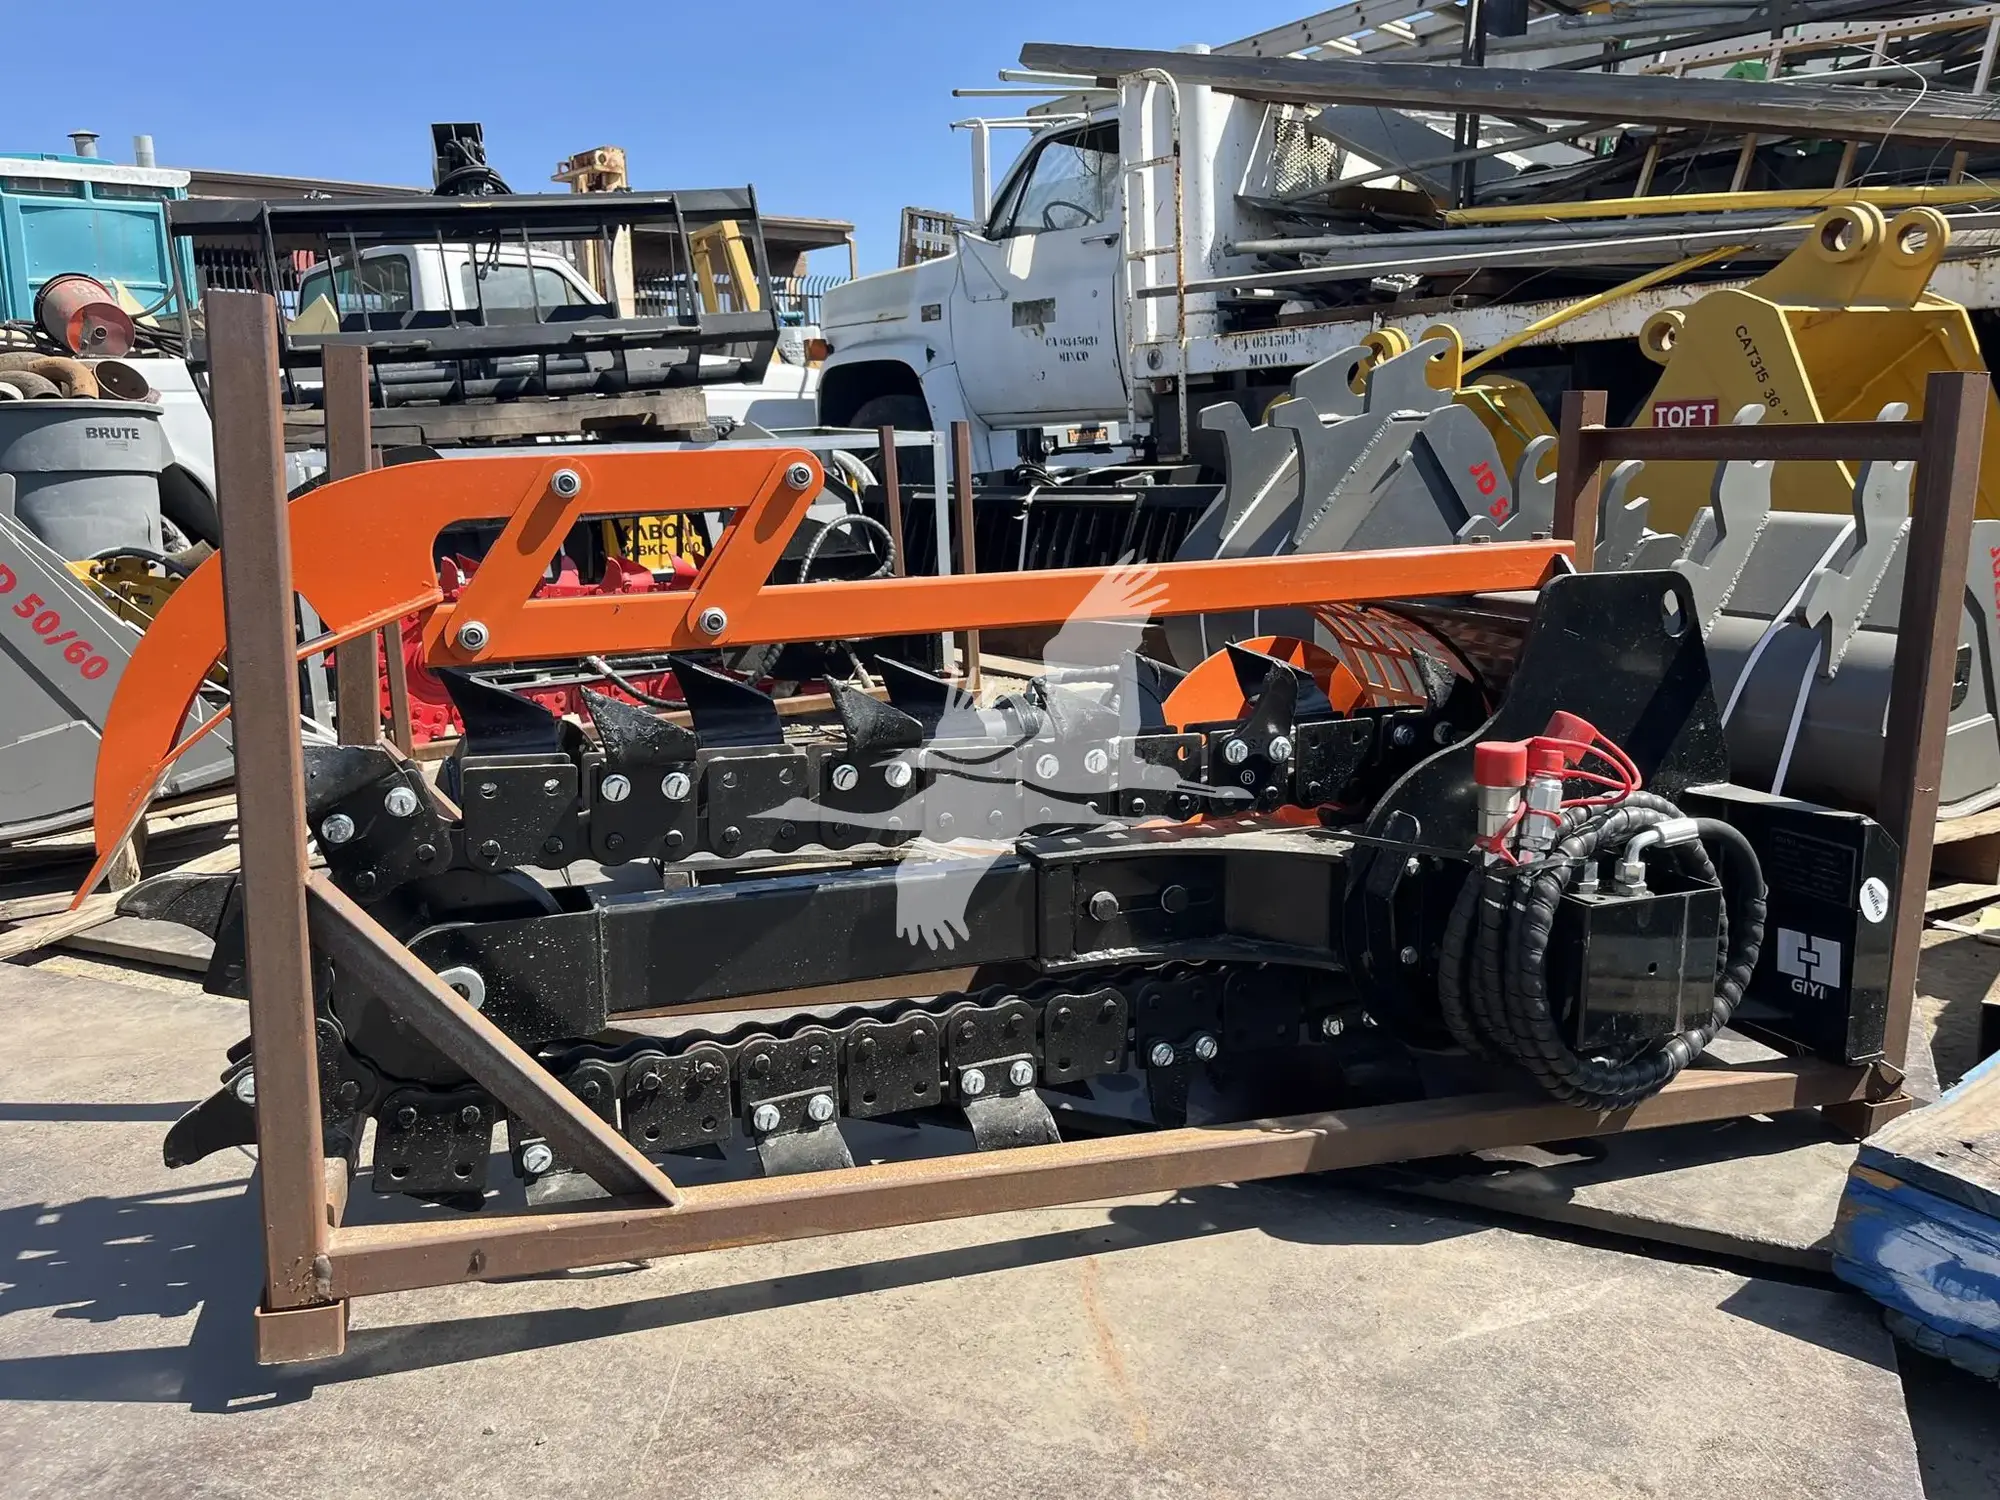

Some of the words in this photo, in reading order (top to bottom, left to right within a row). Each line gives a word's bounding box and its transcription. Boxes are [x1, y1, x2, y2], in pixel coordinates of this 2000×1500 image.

[1249, 352, 1288, 367] MINCO
[1735, 325, 1769, 383] CAT315
[1654, 404, 1715, 428] TOFT
[85, 427, 141, 440] BRUTE
[1468, 460, 1497, 496] JD
[12, 593, 109, 680] 50/60
[1867, 883, 1883, 917] Verified
[1790, 978, 1826, 1000] GIYI
